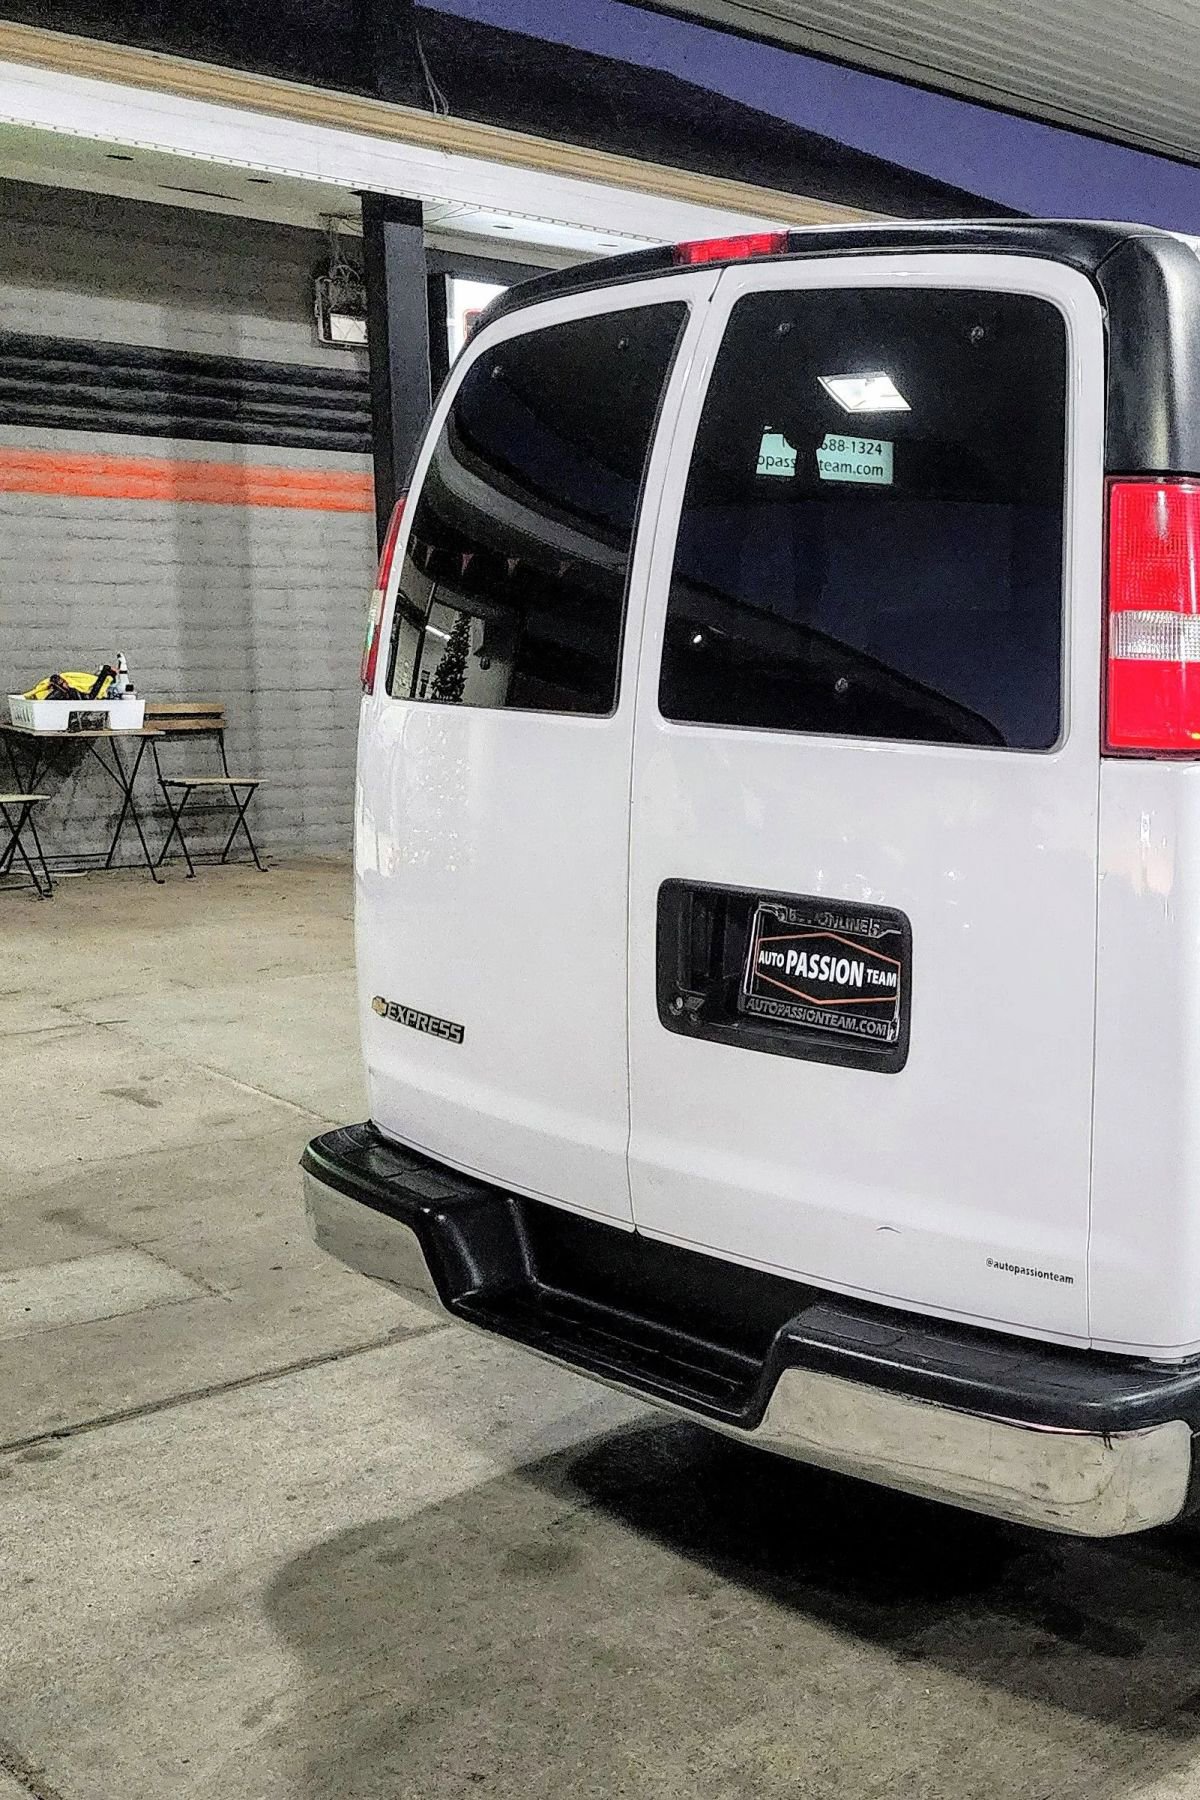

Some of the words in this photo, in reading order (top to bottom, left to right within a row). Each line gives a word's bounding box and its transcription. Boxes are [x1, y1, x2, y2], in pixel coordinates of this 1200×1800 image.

[758, 950, 785, 968] AUTO
[785, 950, 864, 988] PASSION
[866, 969, 897, 988] TEAM
[387, 1002, 463, 1043] EXPRESS
[746, 997, 888, 1036] AUTOPASSIONTEAM.COM
[986, 1258, 1074, 1284] @autopassionteam
